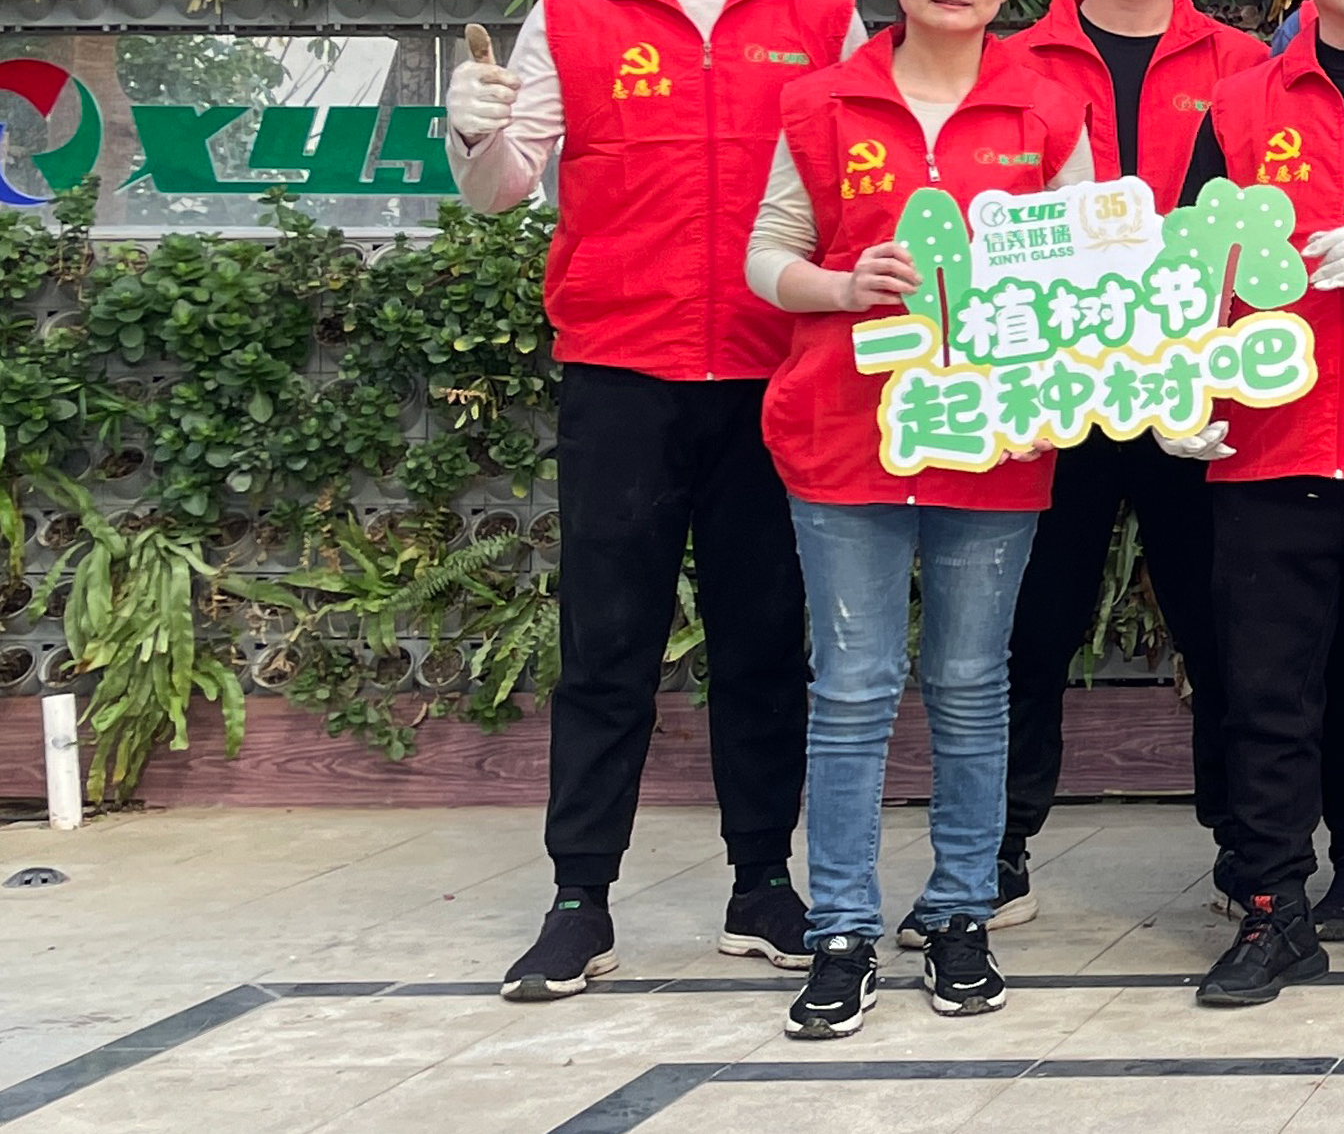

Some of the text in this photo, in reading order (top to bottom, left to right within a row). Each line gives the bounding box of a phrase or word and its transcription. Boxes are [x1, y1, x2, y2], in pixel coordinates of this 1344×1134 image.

[612, 78, 672, 100] 志愿者
[1256, 162, 1311, 184] 志愿者
[841, 172, 896, 200] 志愿者
[1007, 201, 1067, 225] XYG
[1095, 192, 1127, 221] 35
[989, 246, 1075, 267] XINYI GLASS
[956, 265, 1203, 359] 植树节
